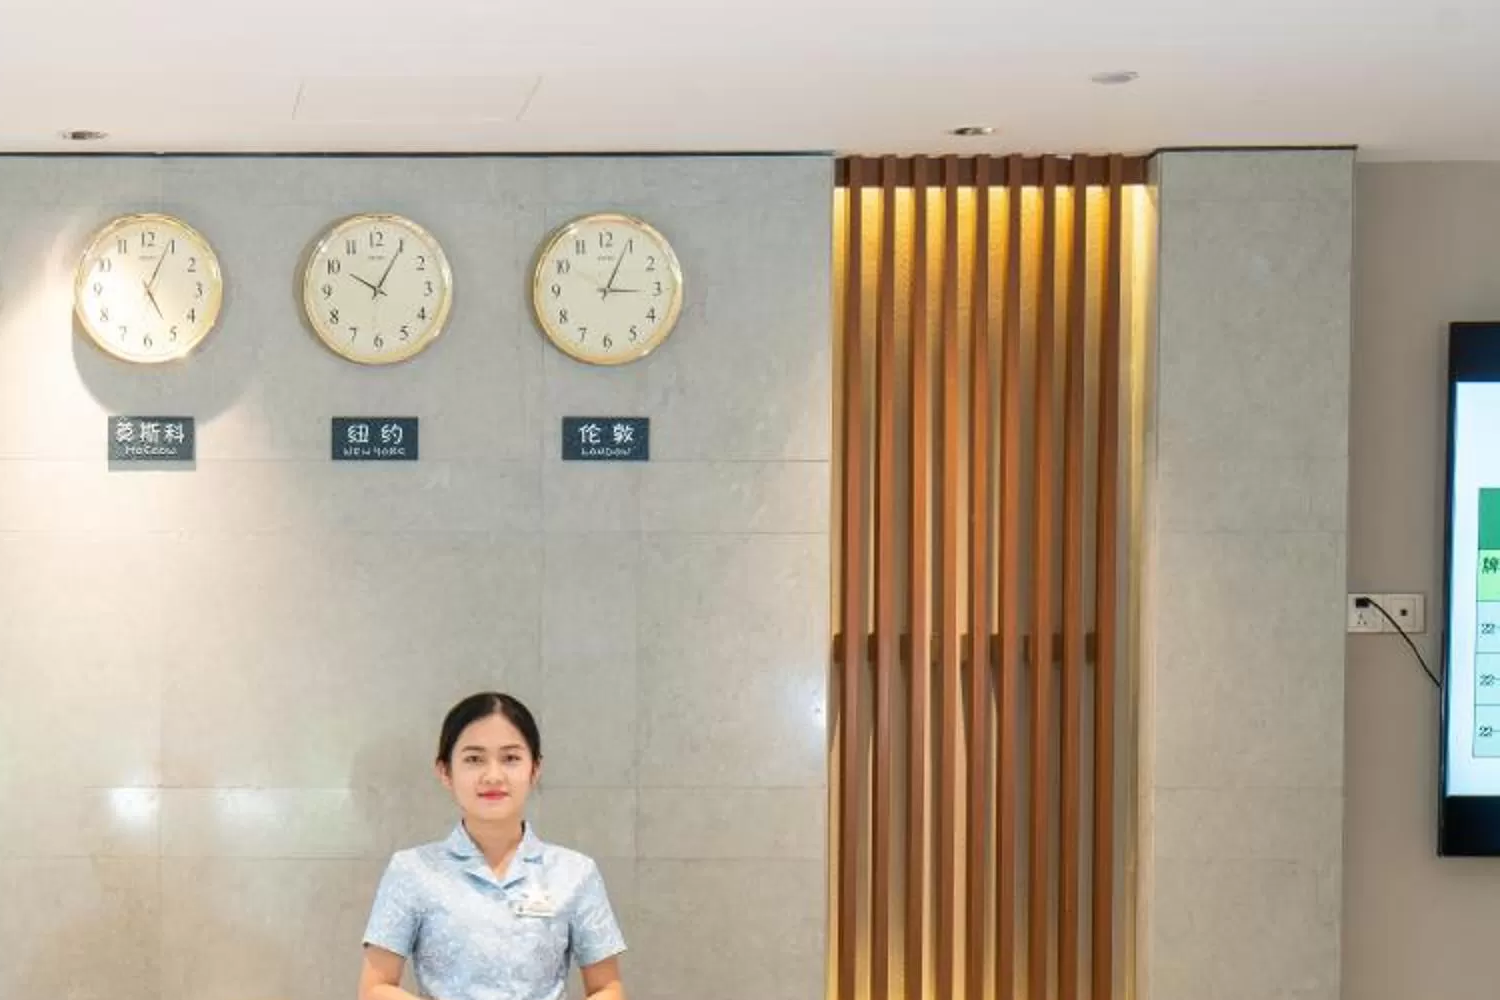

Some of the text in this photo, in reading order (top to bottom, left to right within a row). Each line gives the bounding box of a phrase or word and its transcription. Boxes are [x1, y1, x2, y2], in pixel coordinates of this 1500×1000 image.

[117, 239, 127, 254] 11
[141, 231, 155, 248] 12
[346, 239, 356, 255] 11
[369, 231, 384, 248] 12
[575, 239, 585, 255] 11
[598, 231, 613, 248] 12
[187, 257, 196, 273] 2
[327, 258, 340, 275] 10
[416, 255, 425, 271] 2
[556, 259, 571, 274] 10
[645, 255, 655, 272] 2
[195, 281, 203, 298] 3
[321, 283, 332, 300] 9
[424, 280, 433, 297] 3
[551, 283, 561, 299] 9
[651, 281, 663, 297] 3
[186, 308, 195, 323] 4
[329, 308, 339, 324] 8
[417, 306, 426, 320] 4
[559, 307, 568, 324] 8
[645, 307, 656, 322] 4
[118, 325, 127, 341] 7
[143, 332, 153, 348] 6
[169, 325, 178, 341] 5
[348, 327, 357, 342] 7
[400, 325, 409, 341] 5
[578, 327, 587, 341] 7
[628, 325, 637, 342] 5
[373, 334, 384, 349] 6
[603, 333, 613, 350] 6
[115, 421, 184, 443] 莫斯科
[347, 423, 403, 444] 纽约
[578, 423, 634, 444] 伦敦
